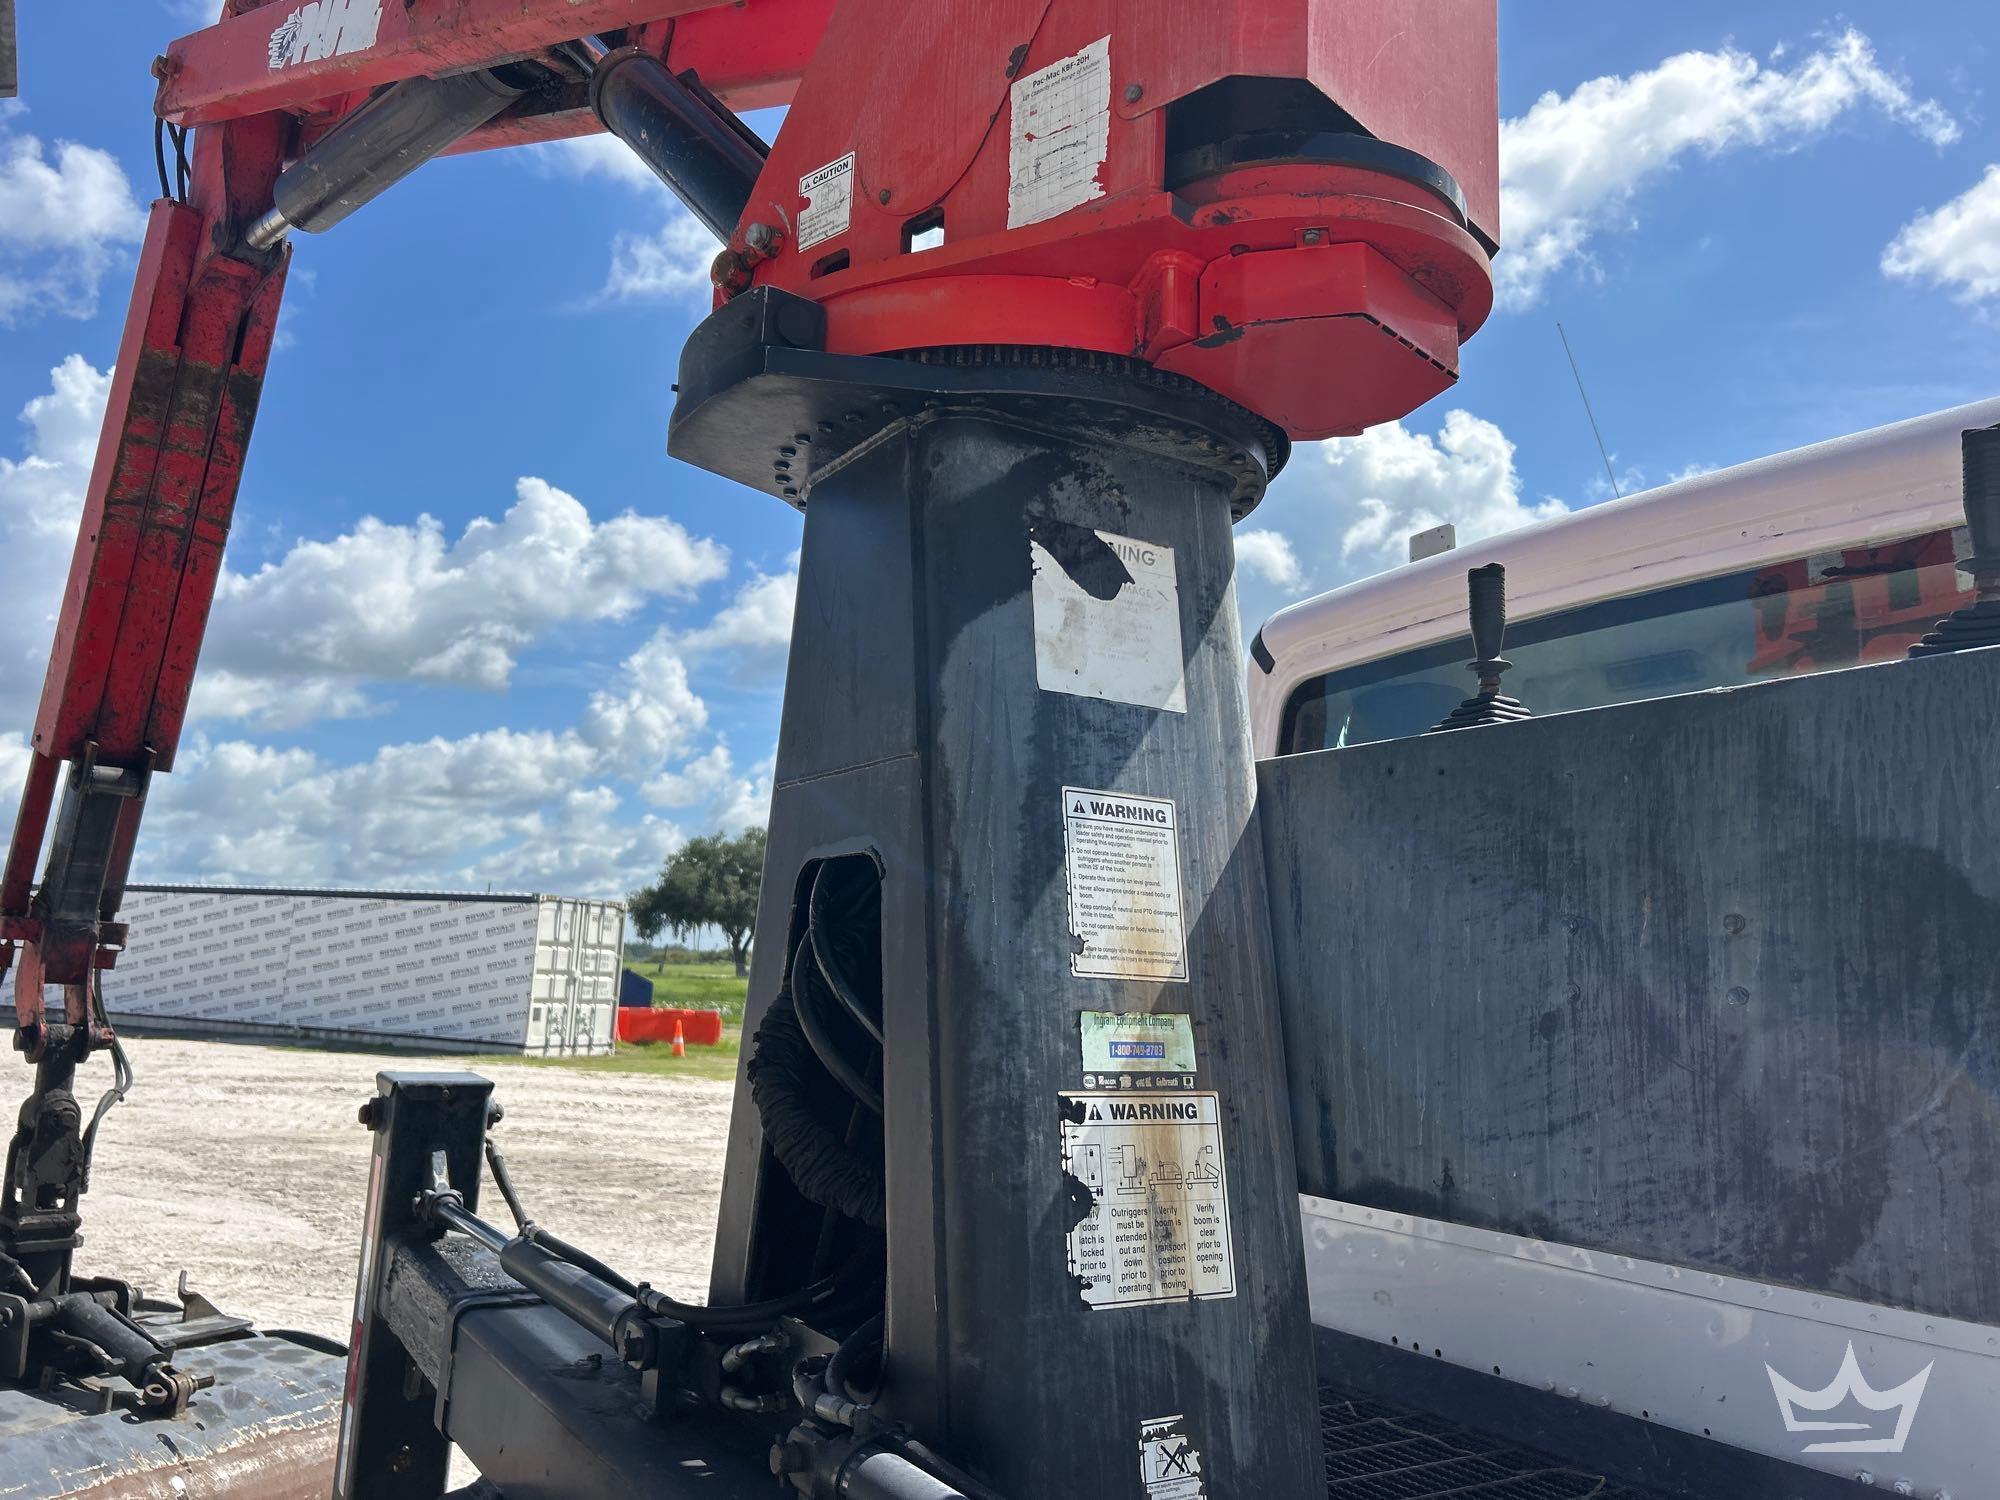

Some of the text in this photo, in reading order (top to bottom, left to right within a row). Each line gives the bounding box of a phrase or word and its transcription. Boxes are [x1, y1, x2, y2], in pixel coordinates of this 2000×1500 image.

[1032, 66, 1061, 88] Pac-Mac
[1061, 54, 1090, 73] KBF-20H
[813, 161, 848, 184] CAUTION
[1109, 542, 1156, 566] NING
[1090, 801, 1167, 823] WARNING
[1094, 1013, 1115, 1028] Ingram
[1148, 1015, 1175, 1030] Company
[1109, 1103, 1198, 1120] WARNING
[1111, 1208, 1148, 1219] Outriggers
[1158, 1206, 1177, 1216] Verify
[1196, 1203, 1215, 1214] Verify
[1116, 1221, 1133, 1229] must
[1155, 1218, 1173, 1227] boom
[1194, 1215, 1220, 1225] boom is
[1082, 1224, 1099, 1232] door
[1200, 1228, 1215, 1237] clear
[1098, 1235, 1105, 1244] is
[1116, 1232, 1148, 1242] extended
[1119, 1245, 1146, 1255] out and
[1156, 1242, 1186, 1252] transport
[1197, 1239, 1221, 1250] prior to
[1080, 1248, 1104, 1258] locked
[1197, 1251, 1223, 1263] opening
[1124, 1258, 1142, 1267] down
[1159, 1255, 1185, 1266] position
[1080, 1261, 1106, 1273] prior to
[1203, 1264, 1219, 1274] body
[1082, 1273, 1111, 1284] perating
[1121, 1270, 1146, 1281] prior to
[1160, 1267, 1185, 1279] prior to
[1118, 1282, 1152, 1294] operating
[1161, 1279, 1186, 1290] moving
